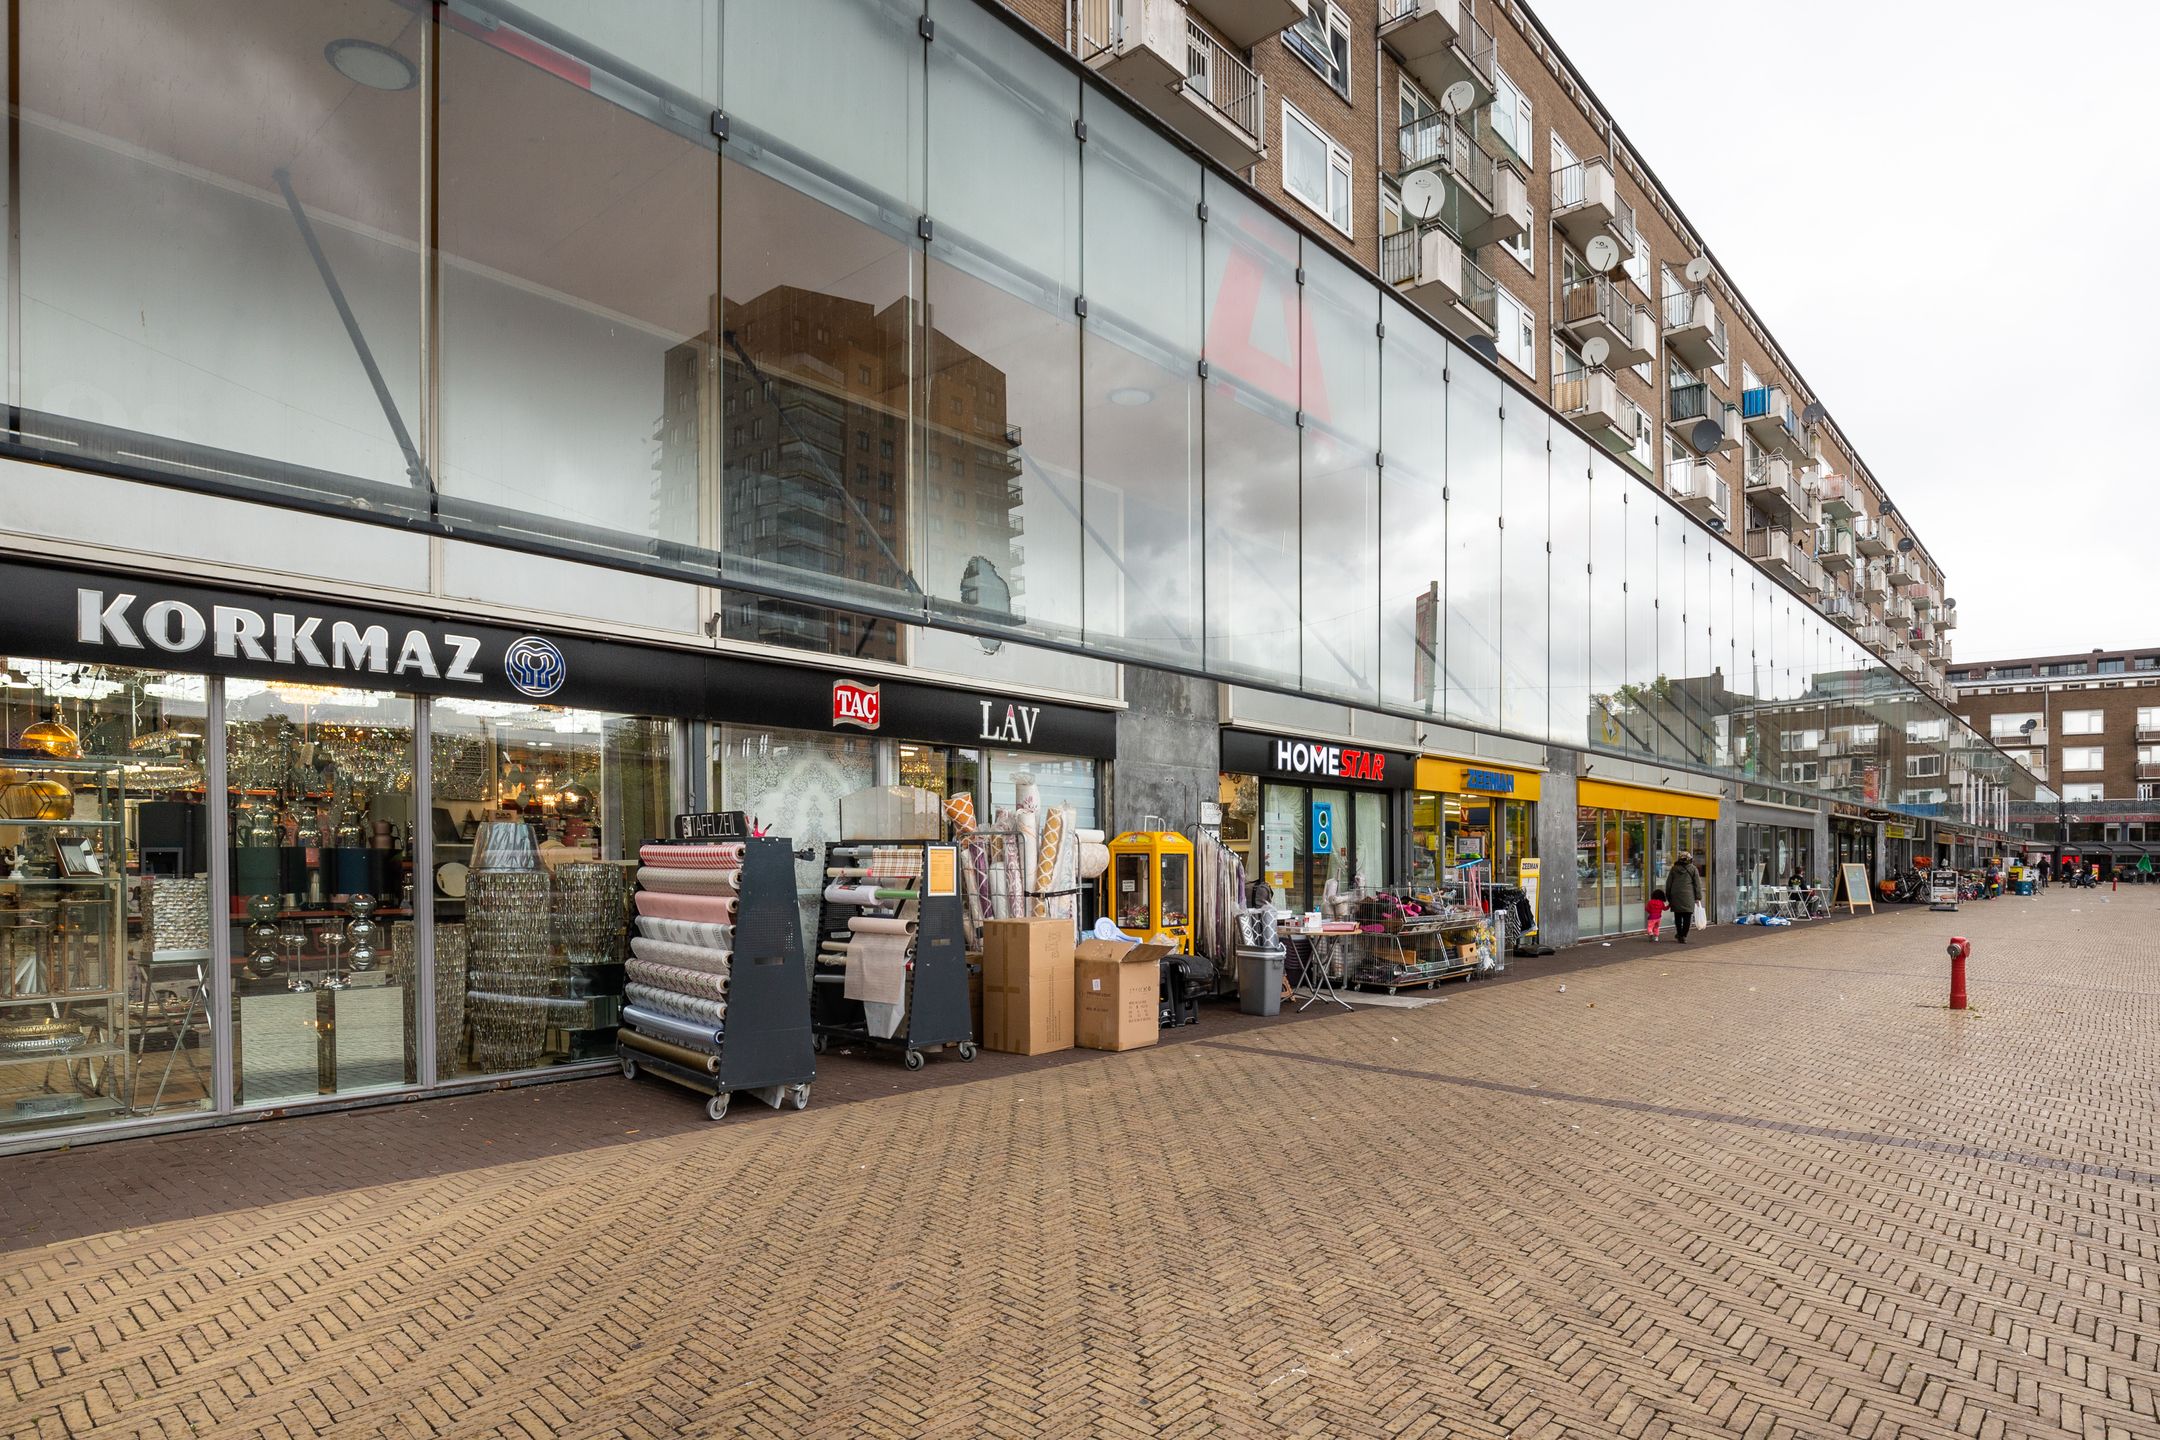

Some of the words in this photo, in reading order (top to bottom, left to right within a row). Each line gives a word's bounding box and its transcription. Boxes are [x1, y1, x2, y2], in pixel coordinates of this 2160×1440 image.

[77, 587, 484, 684] KORKMAZ
[979, 699, 1041, 744] LAV
[1466, 767, 1515, 793] ZEEMAN
[690, 812, 740, 838] TAFELZEIL
[1521, 861, 1539, 871] ZEEMAN
